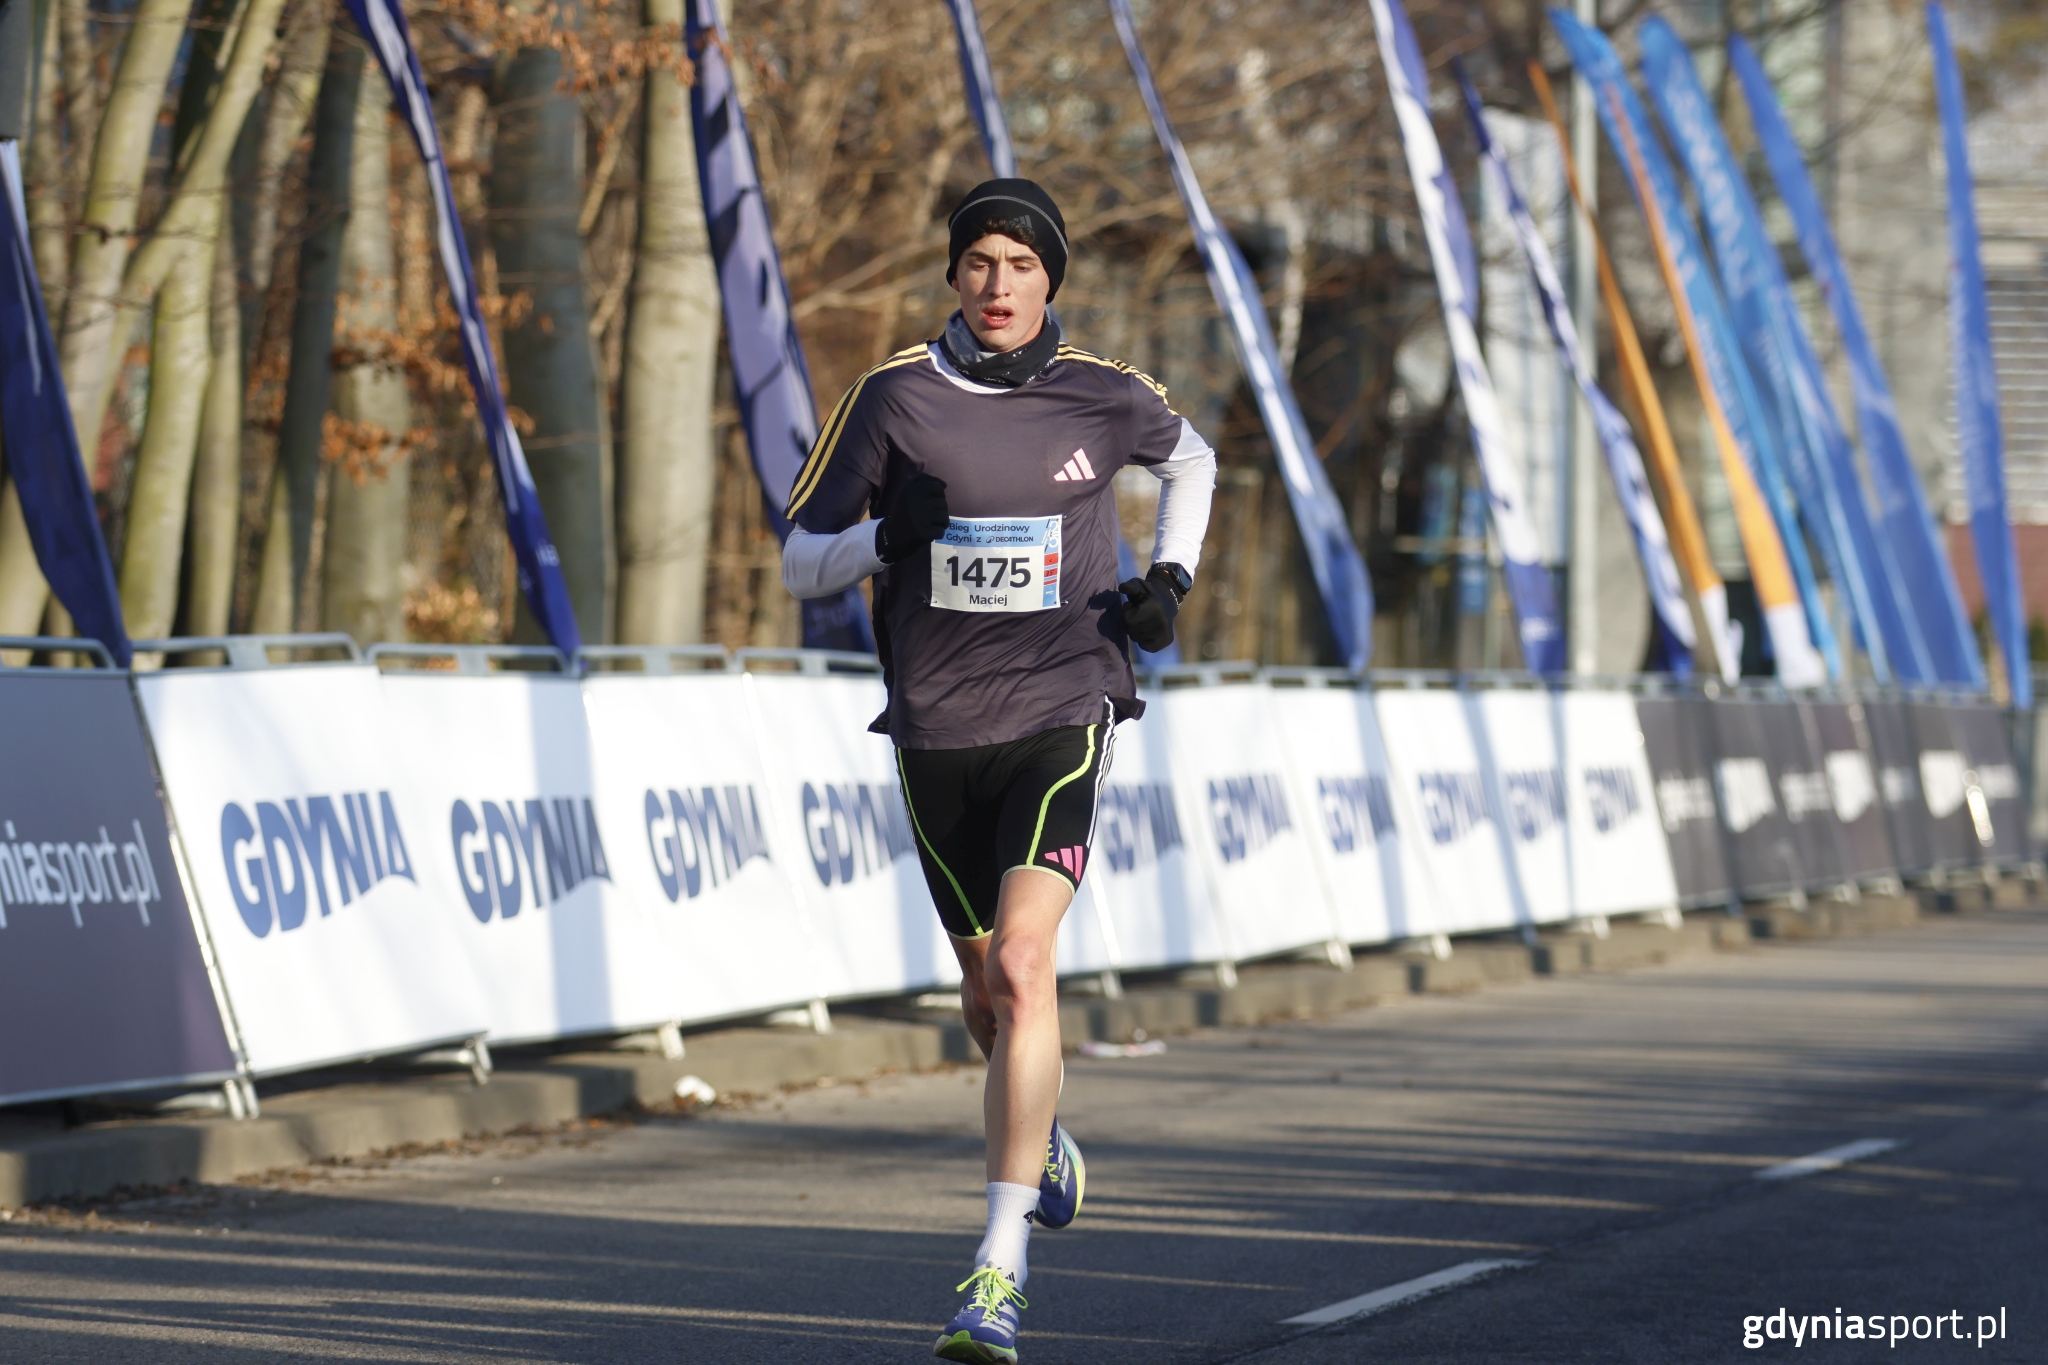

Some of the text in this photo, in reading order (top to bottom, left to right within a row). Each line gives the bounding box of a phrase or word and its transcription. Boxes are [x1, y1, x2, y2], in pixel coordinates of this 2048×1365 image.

[946, 533, 972, 543] Gdyni
[949, 523, 1030, 533] Bieg Urodzinowy
[947, 556, 1031, 588] 1475
[969, 595, 1007, 606] Maciej
[0, 818, 161, 929] niasport.pl
[221, 789, 419, 938] GDYNIA
[451, 795, 614, 924] GDYNIA
[645, 783, 769, 902] GDYNIA
